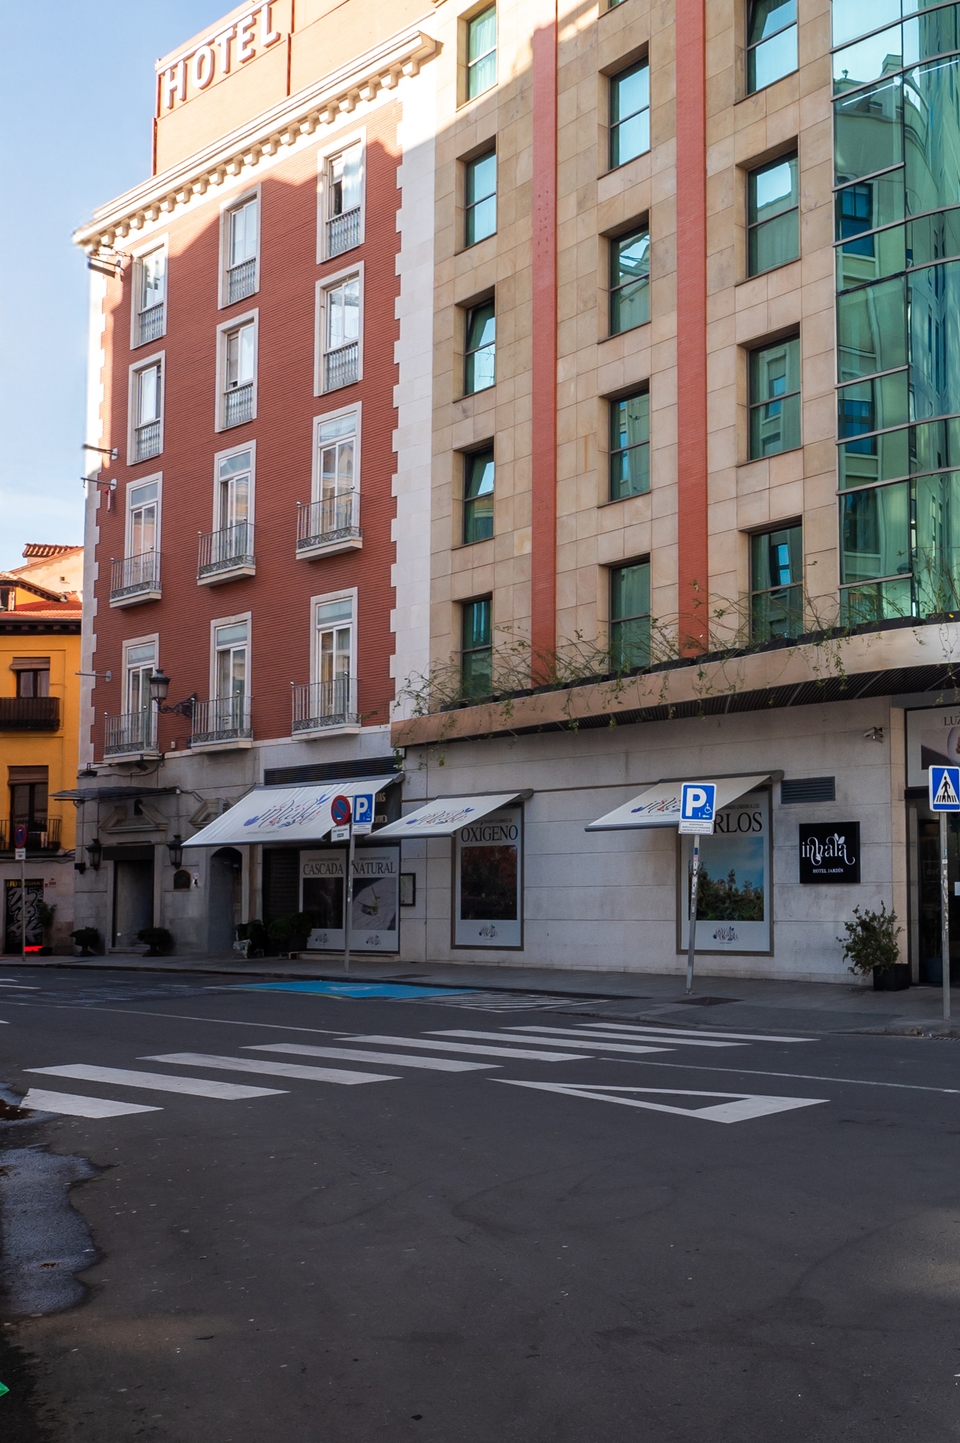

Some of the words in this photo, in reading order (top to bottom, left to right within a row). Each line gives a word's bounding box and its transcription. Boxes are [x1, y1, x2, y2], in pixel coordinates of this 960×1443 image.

[163, 4, 281, 109] HOTEL
[356, 797, 369, 821] P
[685, 788, 707, 816] P
[461, 822, 518, 843] OXÍGENO
[802, 833, 856, 866] inhala
[303, 863, 344, 875] CASCADA
[353, 861, 396, 875] NATURAL
